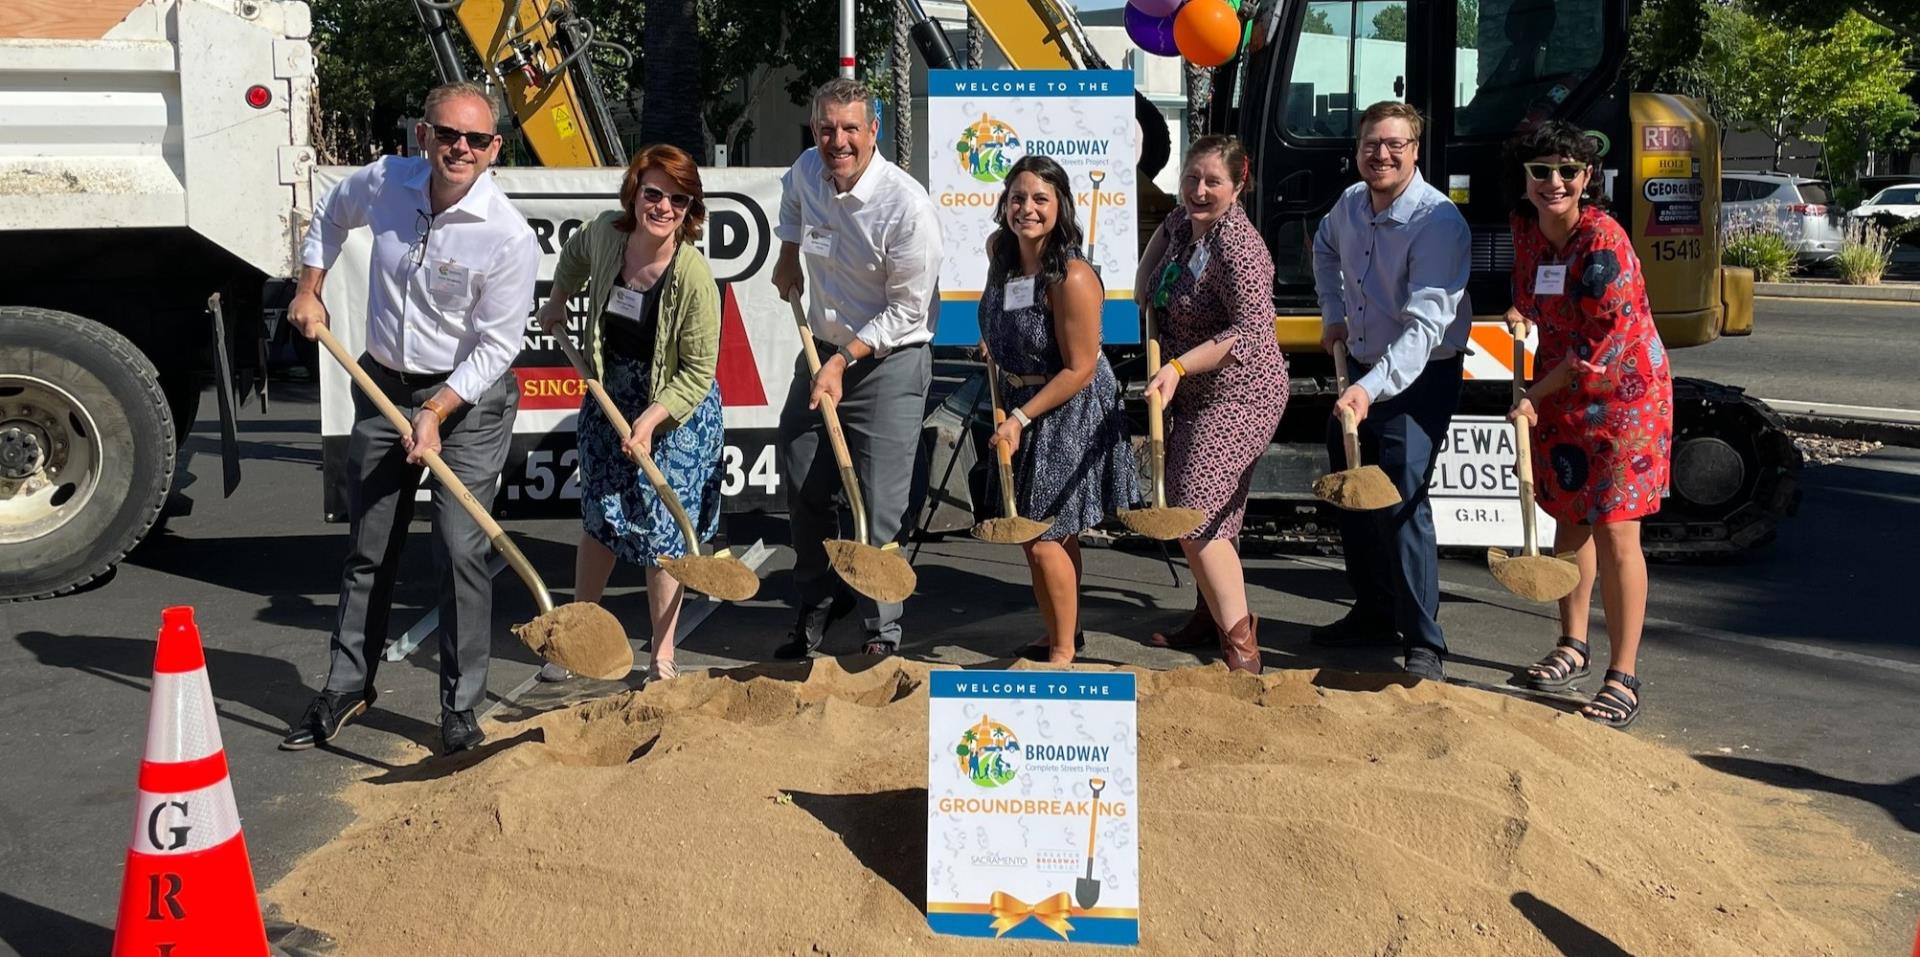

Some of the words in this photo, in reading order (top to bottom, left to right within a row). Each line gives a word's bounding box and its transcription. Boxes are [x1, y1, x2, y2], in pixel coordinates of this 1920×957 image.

[956, 82, 1036, 92] WELCOME
[1048, 82, 1067, 92] TO
[1079, 82, 1109, 92] THE
[1026, 140, 1109, 155] BROADWAY
[1651, 238, 1701, 261] 15413
[1440, 427, 1514, 455] DEWA
[720, 444, 780, 495] 34
[1455, 508, 1505, 522] G.R.I.
[956, 683, 1037, 694] WELCOME
[1048, 684, 1068, 695] TO
[1079, 685, 1109, 696] THE
[1025, 744, 1110, 762] BROADWAY
[1025, 763, 1058, 773] Complete
[1060, 764, 1084, 773] Streets
[1086, 766, 1110, 775] Project
[970, 856, 1028, 865] SACRAMENTO
